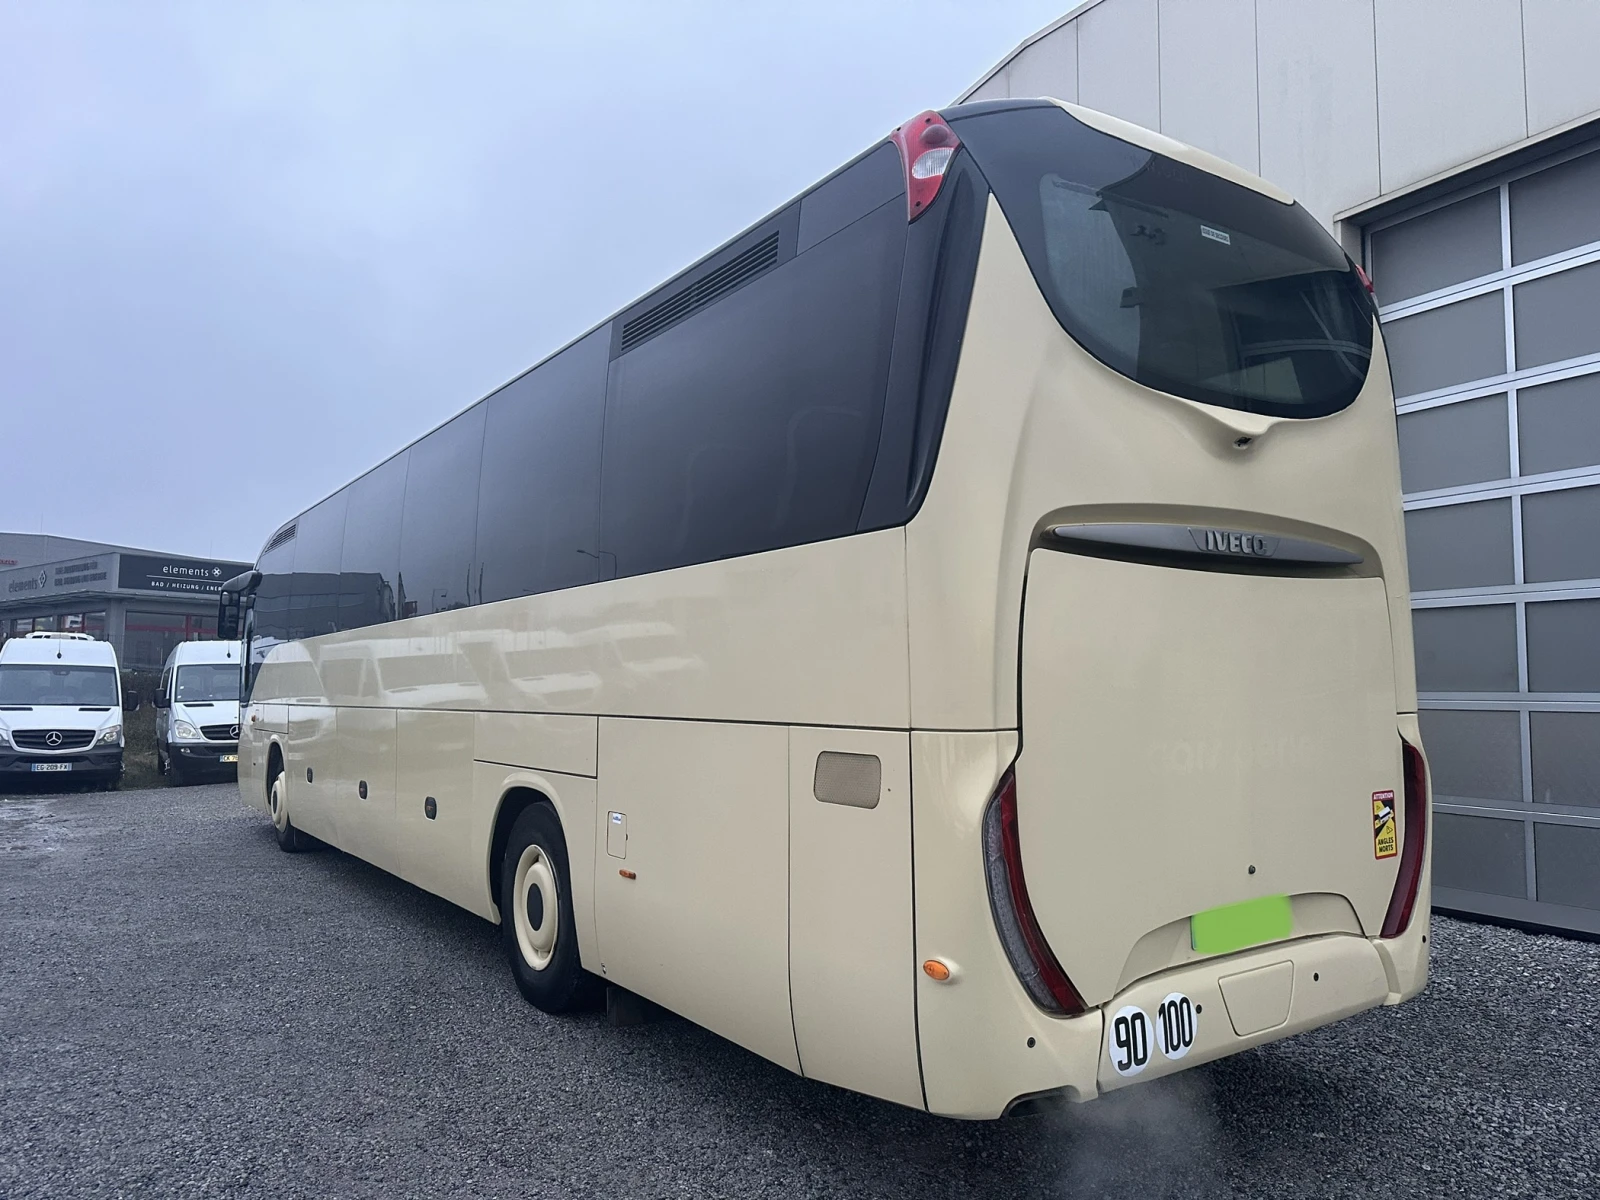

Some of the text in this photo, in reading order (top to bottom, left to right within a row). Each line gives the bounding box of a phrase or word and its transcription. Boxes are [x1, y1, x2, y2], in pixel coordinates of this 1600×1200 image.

[1205, 529, 1268, 556] IVECO
[162, 564, 209, 577] elements
[151, 580, 164, 588] BAD
[171, 582, 199, 591] HEIZUNG
[1378, 837, 1394, 845] ANGLES
[1379, 844, 1394, 853] MORTS
[1158, 996, 1193, 1055] 100
[1114, 1011, 1148, 1072] 90
